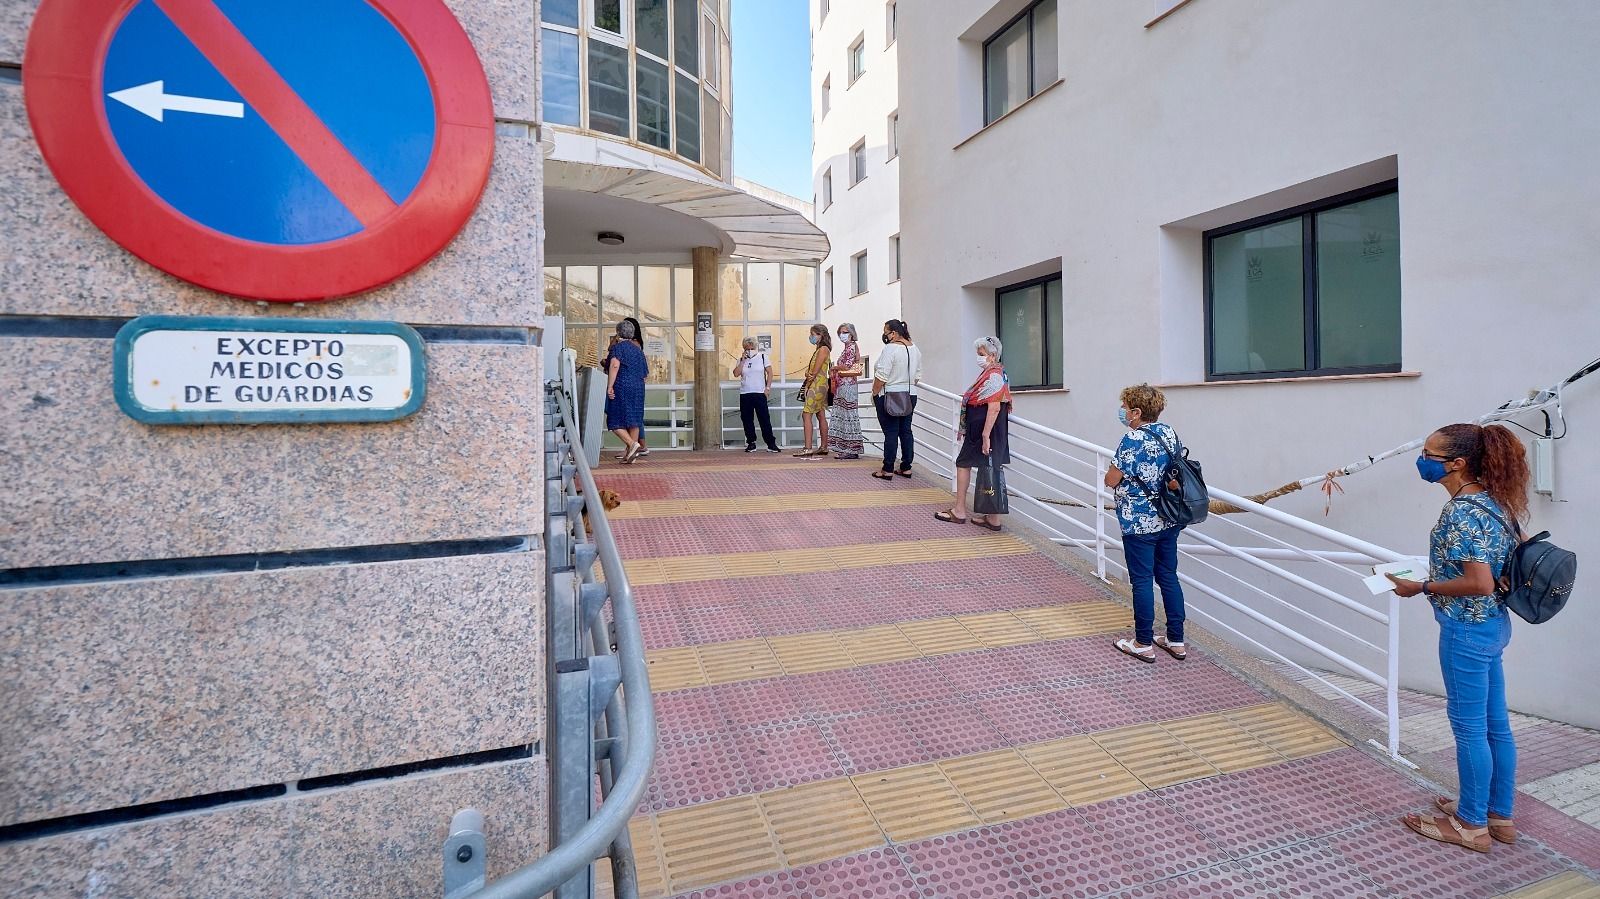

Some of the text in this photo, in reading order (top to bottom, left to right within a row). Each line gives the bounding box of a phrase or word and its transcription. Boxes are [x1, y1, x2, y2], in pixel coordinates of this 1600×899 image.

[217, 337, 344, 357] EXCEPTO
[210, 361, 344, 380] MEDICOS
[184, 385, 374, 403] DE GUARDIAS
